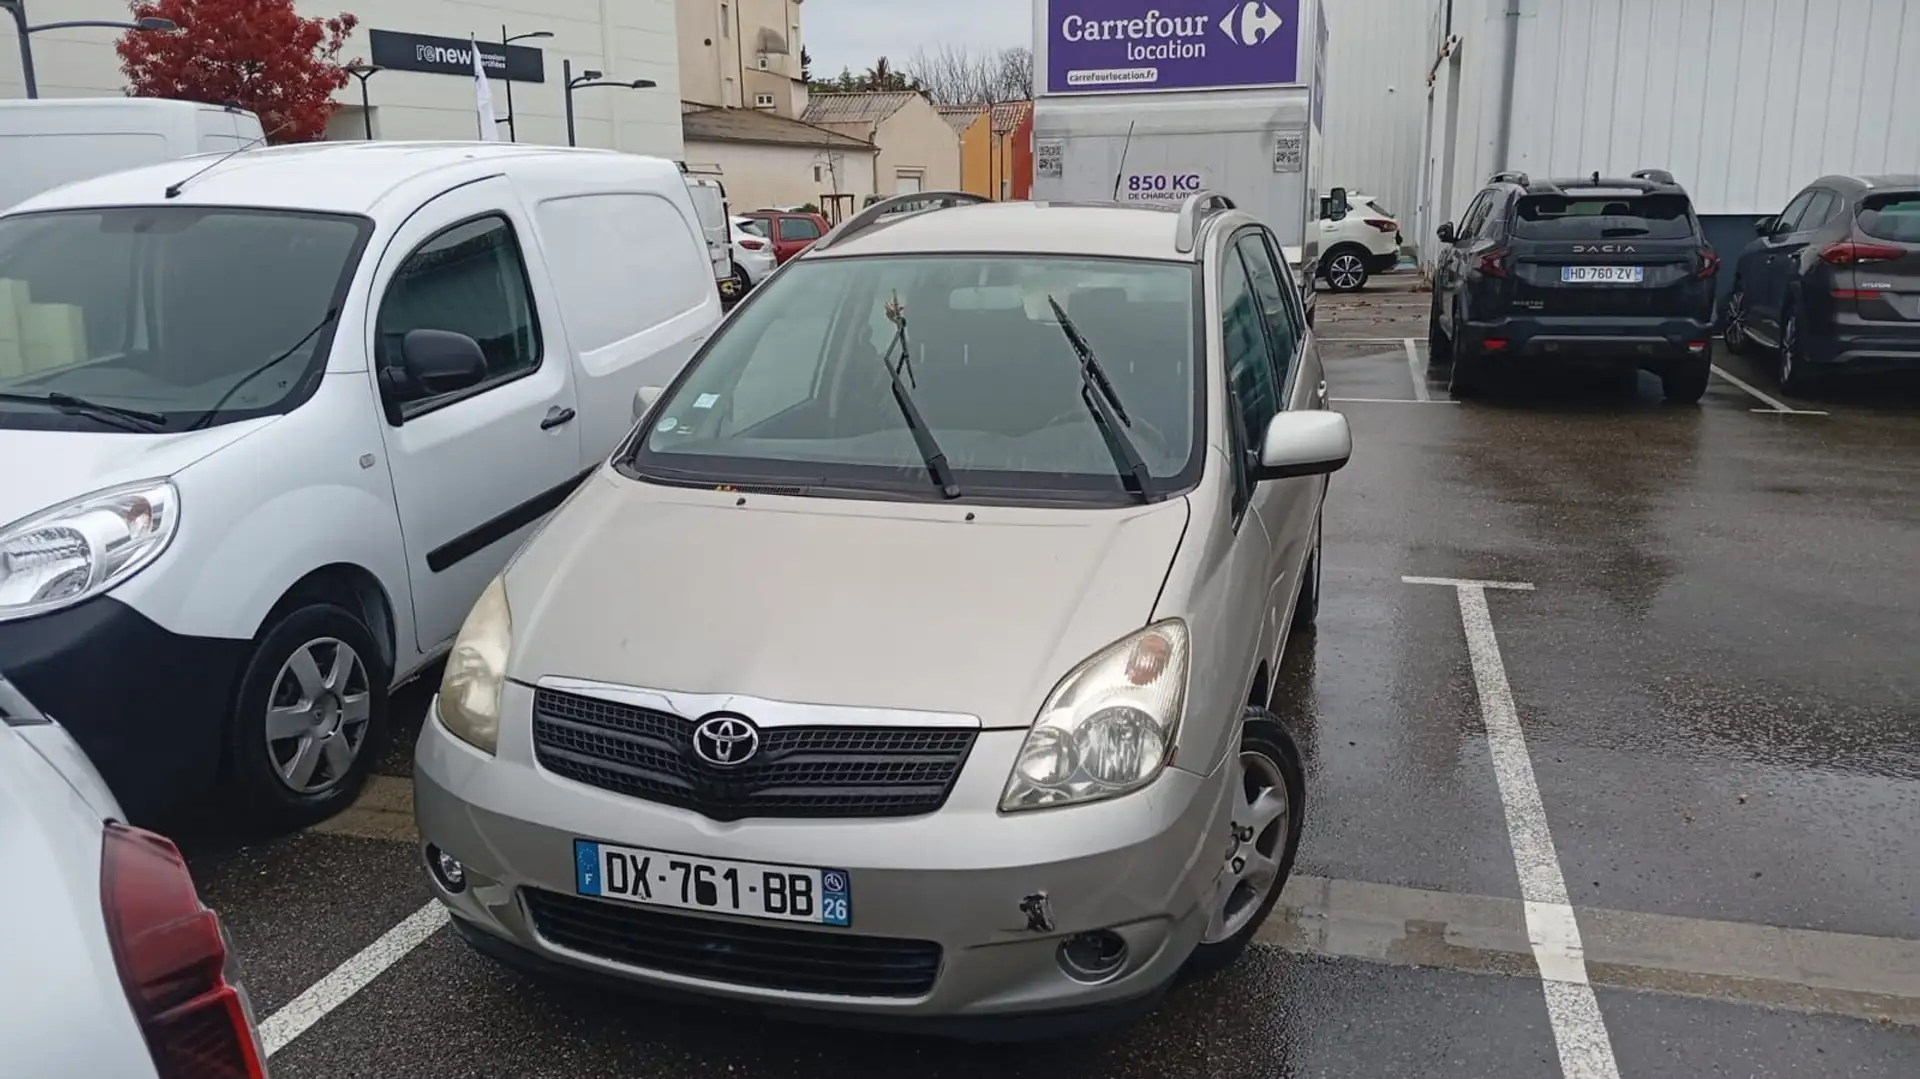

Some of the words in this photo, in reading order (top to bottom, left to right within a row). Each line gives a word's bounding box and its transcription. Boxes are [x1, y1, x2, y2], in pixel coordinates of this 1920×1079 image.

[1062, 9, 1208, 42] Carrefour
[416, 44, 472, 65] renew
[1127, 40, 1206, 60] location
[1069, 70, 1155, 82] carrefourlocation.fr
[1128, 175, 1166, 191] 850
[1172, 174, 1200, 190] KG
[1141, 192, 1174, 200] CHARGE
[1572, 245, 1636, 253] DACIA
[585, 873, 593, 885] F
[824, 899, 847, 920] 26
